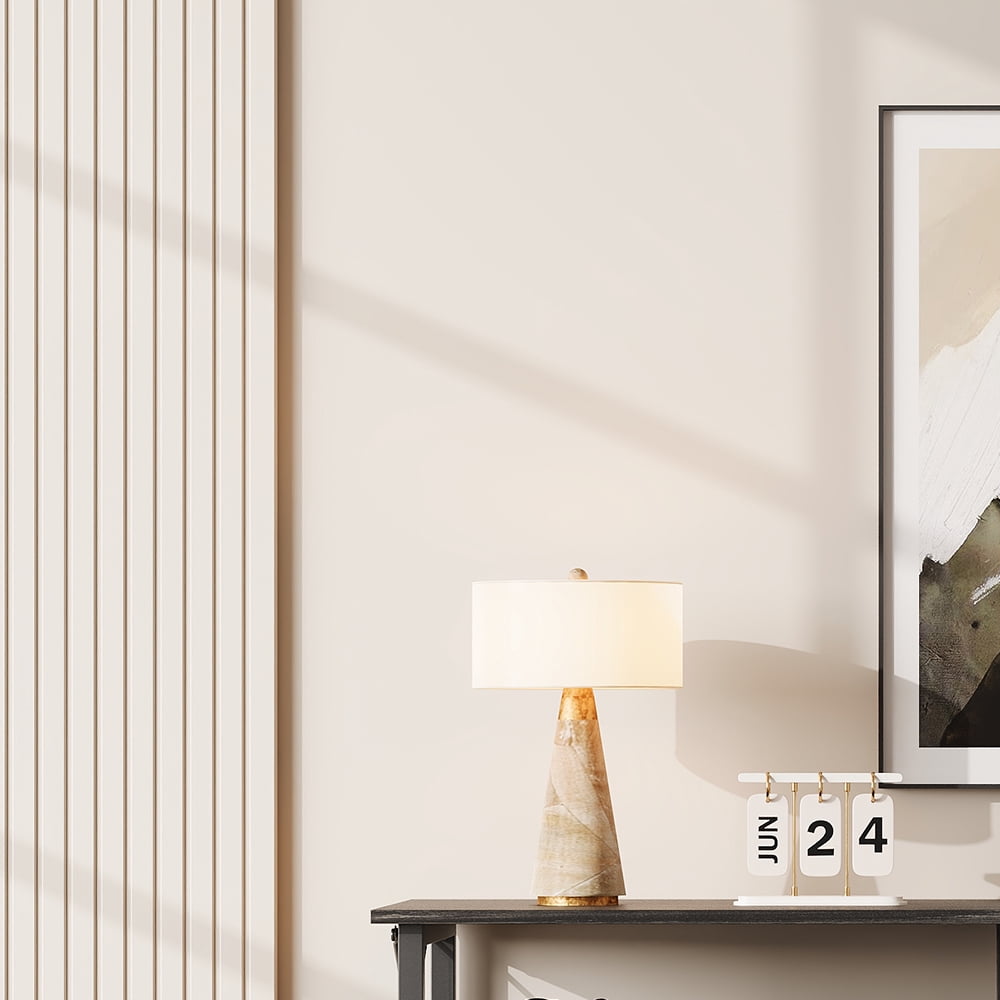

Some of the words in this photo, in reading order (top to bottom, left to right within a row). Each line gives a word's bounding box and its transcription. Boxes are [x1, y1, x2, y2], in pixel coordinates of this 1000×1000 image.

[758, 816, 778, 864] JUN
[807, 820, 835, 857] 2
[858, 816, 888, 853] 4
